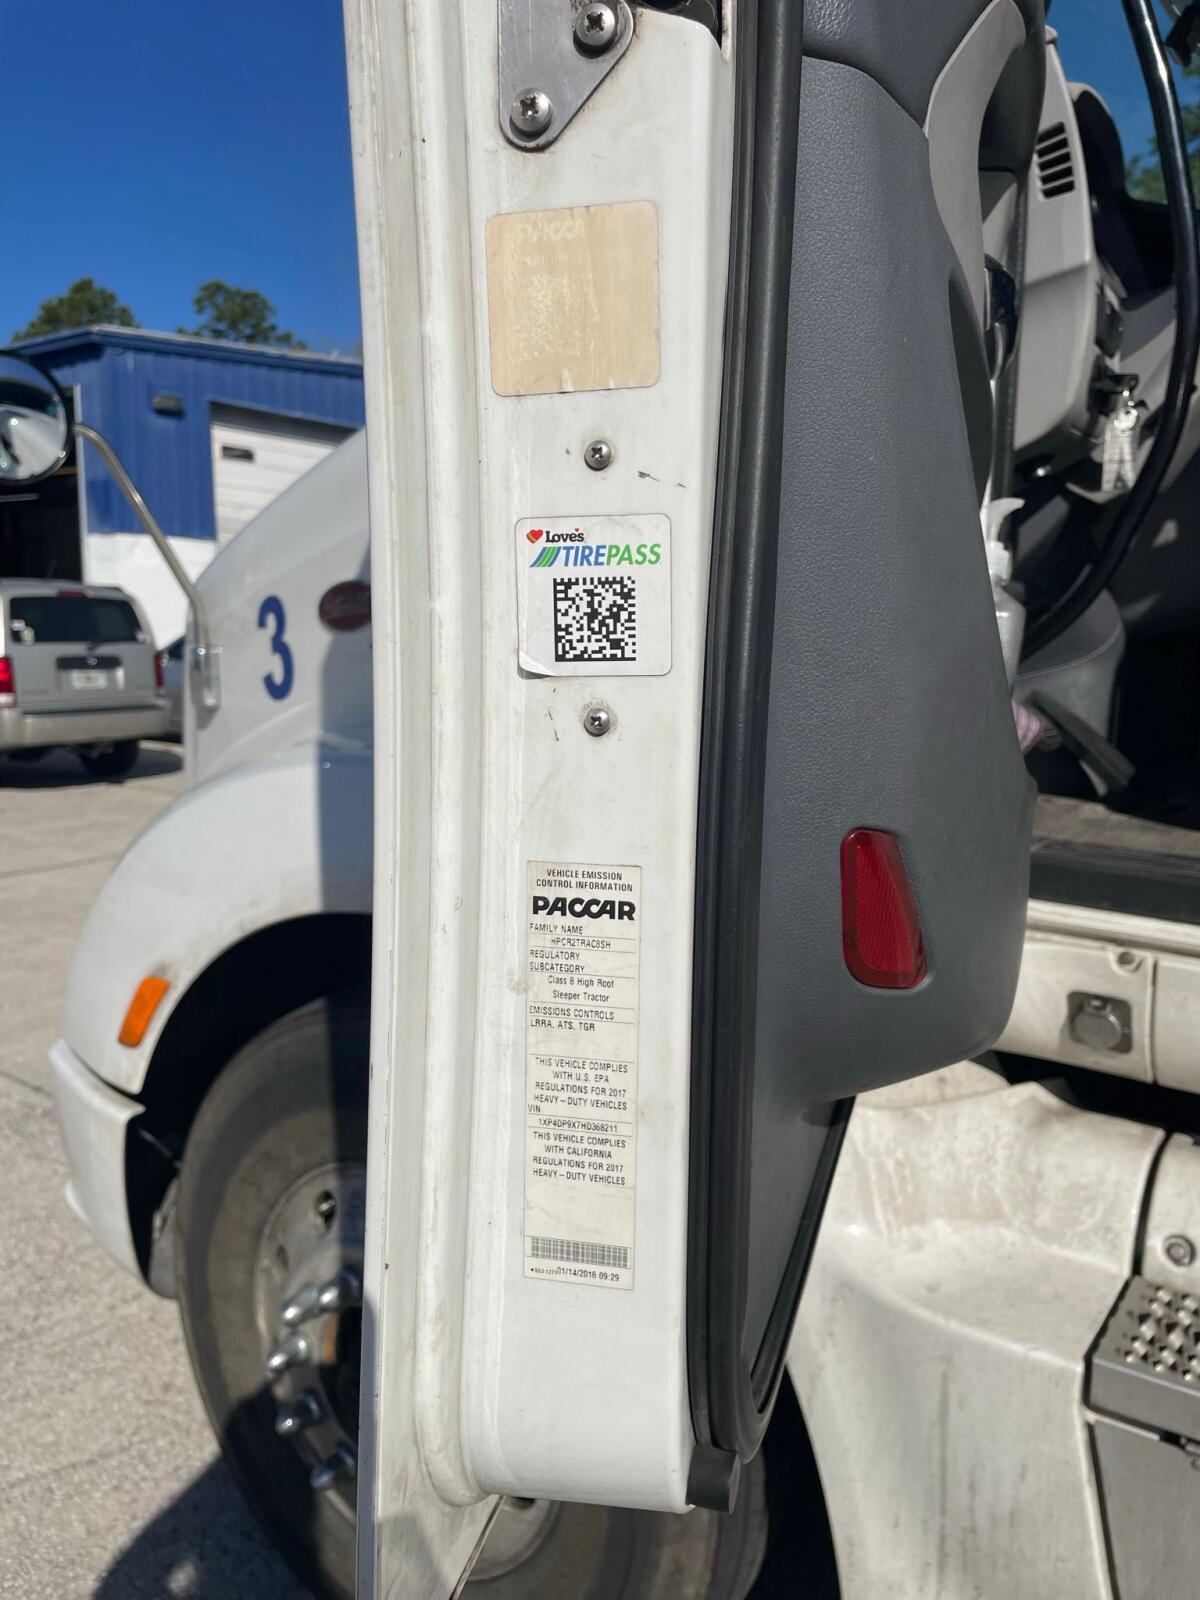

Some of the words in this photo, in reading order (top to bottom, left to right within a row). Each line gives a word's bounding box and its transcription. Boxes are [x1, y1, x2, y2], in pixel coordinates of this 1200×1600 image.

[257, 595, 294, 700] 3
[547, 869, 579, 878] VEHICLE
[582, 871, 622, 880] EMISSION
[536, 879, 573, 888] CONTROL
[576, 882, 632, 892] INFORMATION
[532, 895, 636, 920] PACCAR
[530, 922, 558, 933] FAMILY
[561, 925, 583, 934] NAME
[530, 949, 580, 960] REGULATORY
[529, 961, 585, 973] SUBCATEGORY
[548, 975, 567, 985] Class
[569, 976, 574, 985] 8
[577, 977, 594, 988] High
[552, 990, 580, 1000] Sleeper
[583, 992, 610, 1002] Tractor
[529, 1005, 571, 1017] EMISSIONS
[573, 1009, 615, 1020] CONTROLS
[579, 1022, 595, 1031] TGR
[535, 1057, 552, 1067] THIS
[555, 1059, 586, 1069] VEHICLE
[589, 1061, 628, 1073] COMPLIES
[553, 1070, 573, 1080] WITH
[594, 1074, 609, 1084] EPA
[535, 1081, 588, 1094] REGULATIONS
[591, 1086, 606, 1096] FOR
[609, 1088, 627, 1098] 2017
[528, 1104, 541, 1113] VIN
[534, 1094, 559, 1104] HEAVY
[567, 1097, 588, 1107] DUTY
[590, 1099, 627, 1110] VEHICLES
[533, 1131, 550, 1141] THIS
[553, 1133, 584, 1144] VEHICLE
[587, 1136, 626, 1149] COMPLIES
[544, 1144, 564, 1154] WITH
[567, 1146, 612, 1159] CALIFORNIA
[533, 1156, 585, 1169] REGULATIONS
[588, 1161, 604, 1171] FOR
[606, 1163, 624, 1173] 2017
[533, 1168, 558, 1178] HEAVY
[566, 1171, 586, 1182] DUTY
[589, 1174, 626, 1186] VEHICLES
